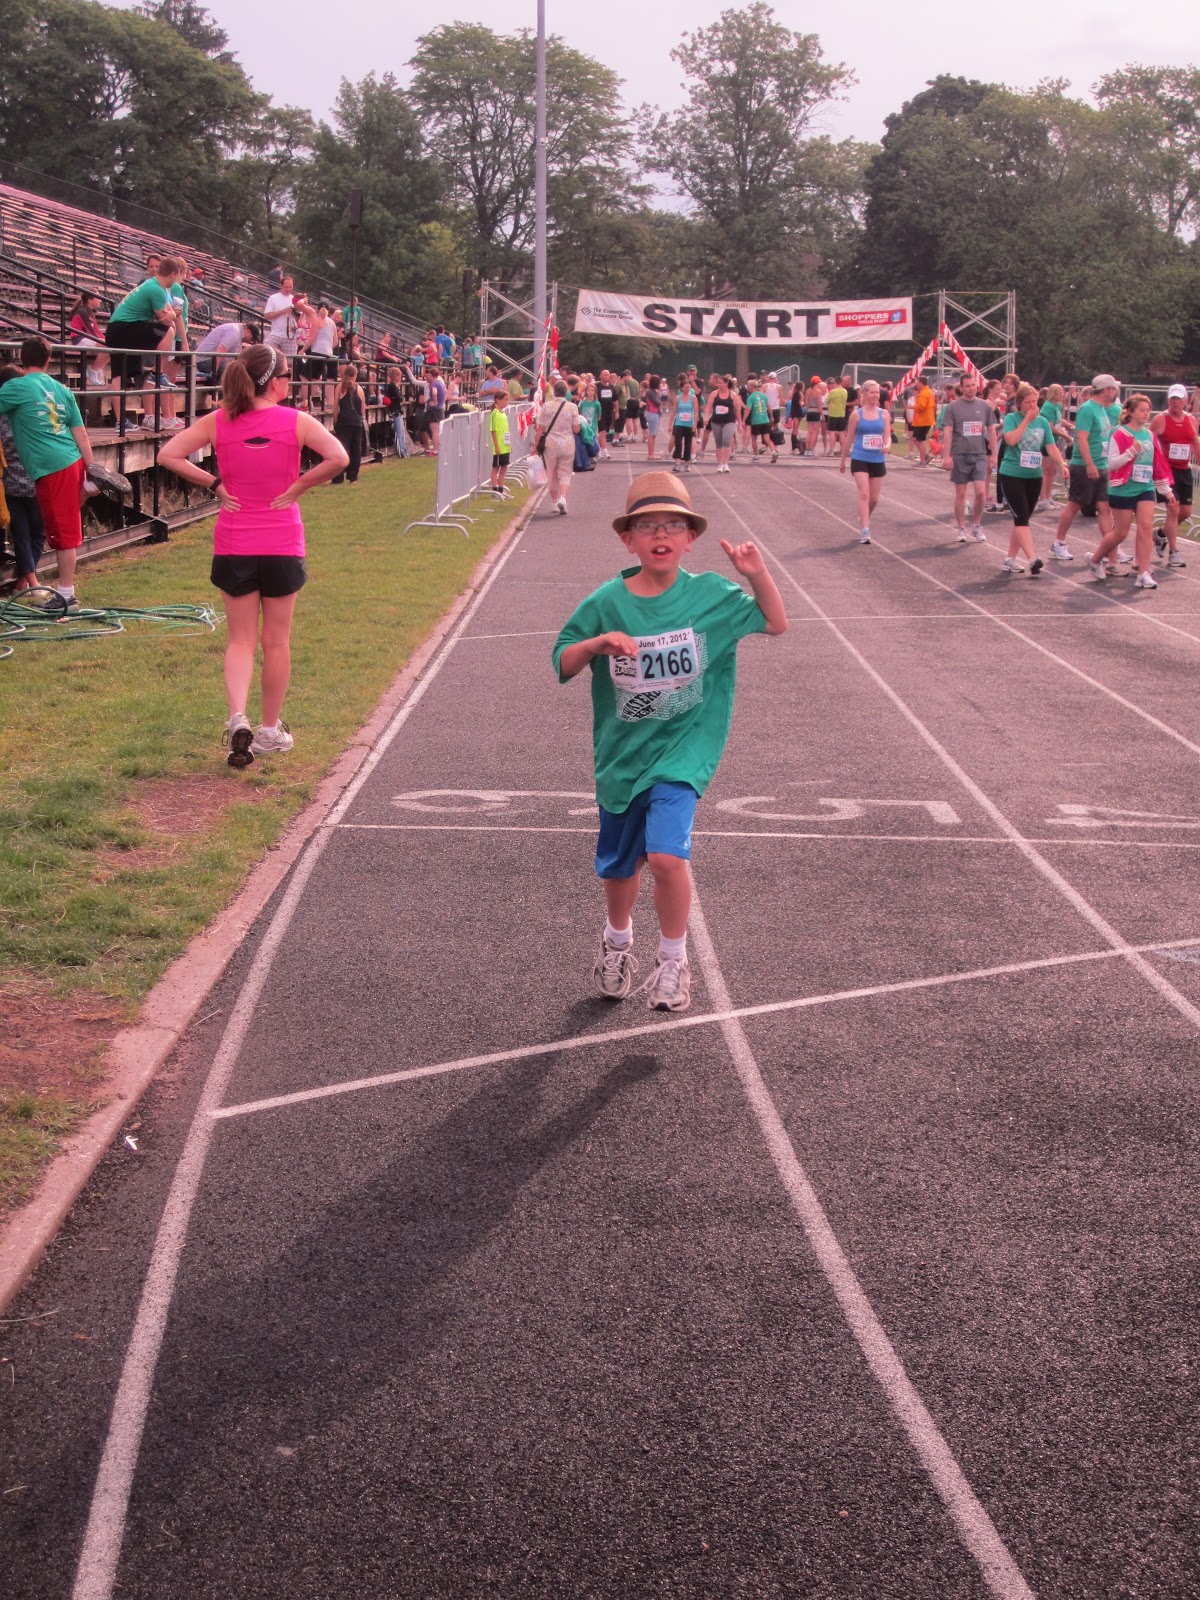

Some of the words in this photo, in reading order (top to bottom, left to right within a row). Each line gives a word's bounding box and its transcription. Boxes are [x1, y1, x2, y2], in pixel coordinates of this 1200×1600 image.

[642, 303, 830, 337] START
[838, 312, 889, 321] SHOPPERS
[638, 640, 656, 648] June
[657, 637, 669, 646] 17,
[669, 632, 688, 643] 2012
[642, 648, 692, 679] 2166
[714, 796, 962, 824] 5
